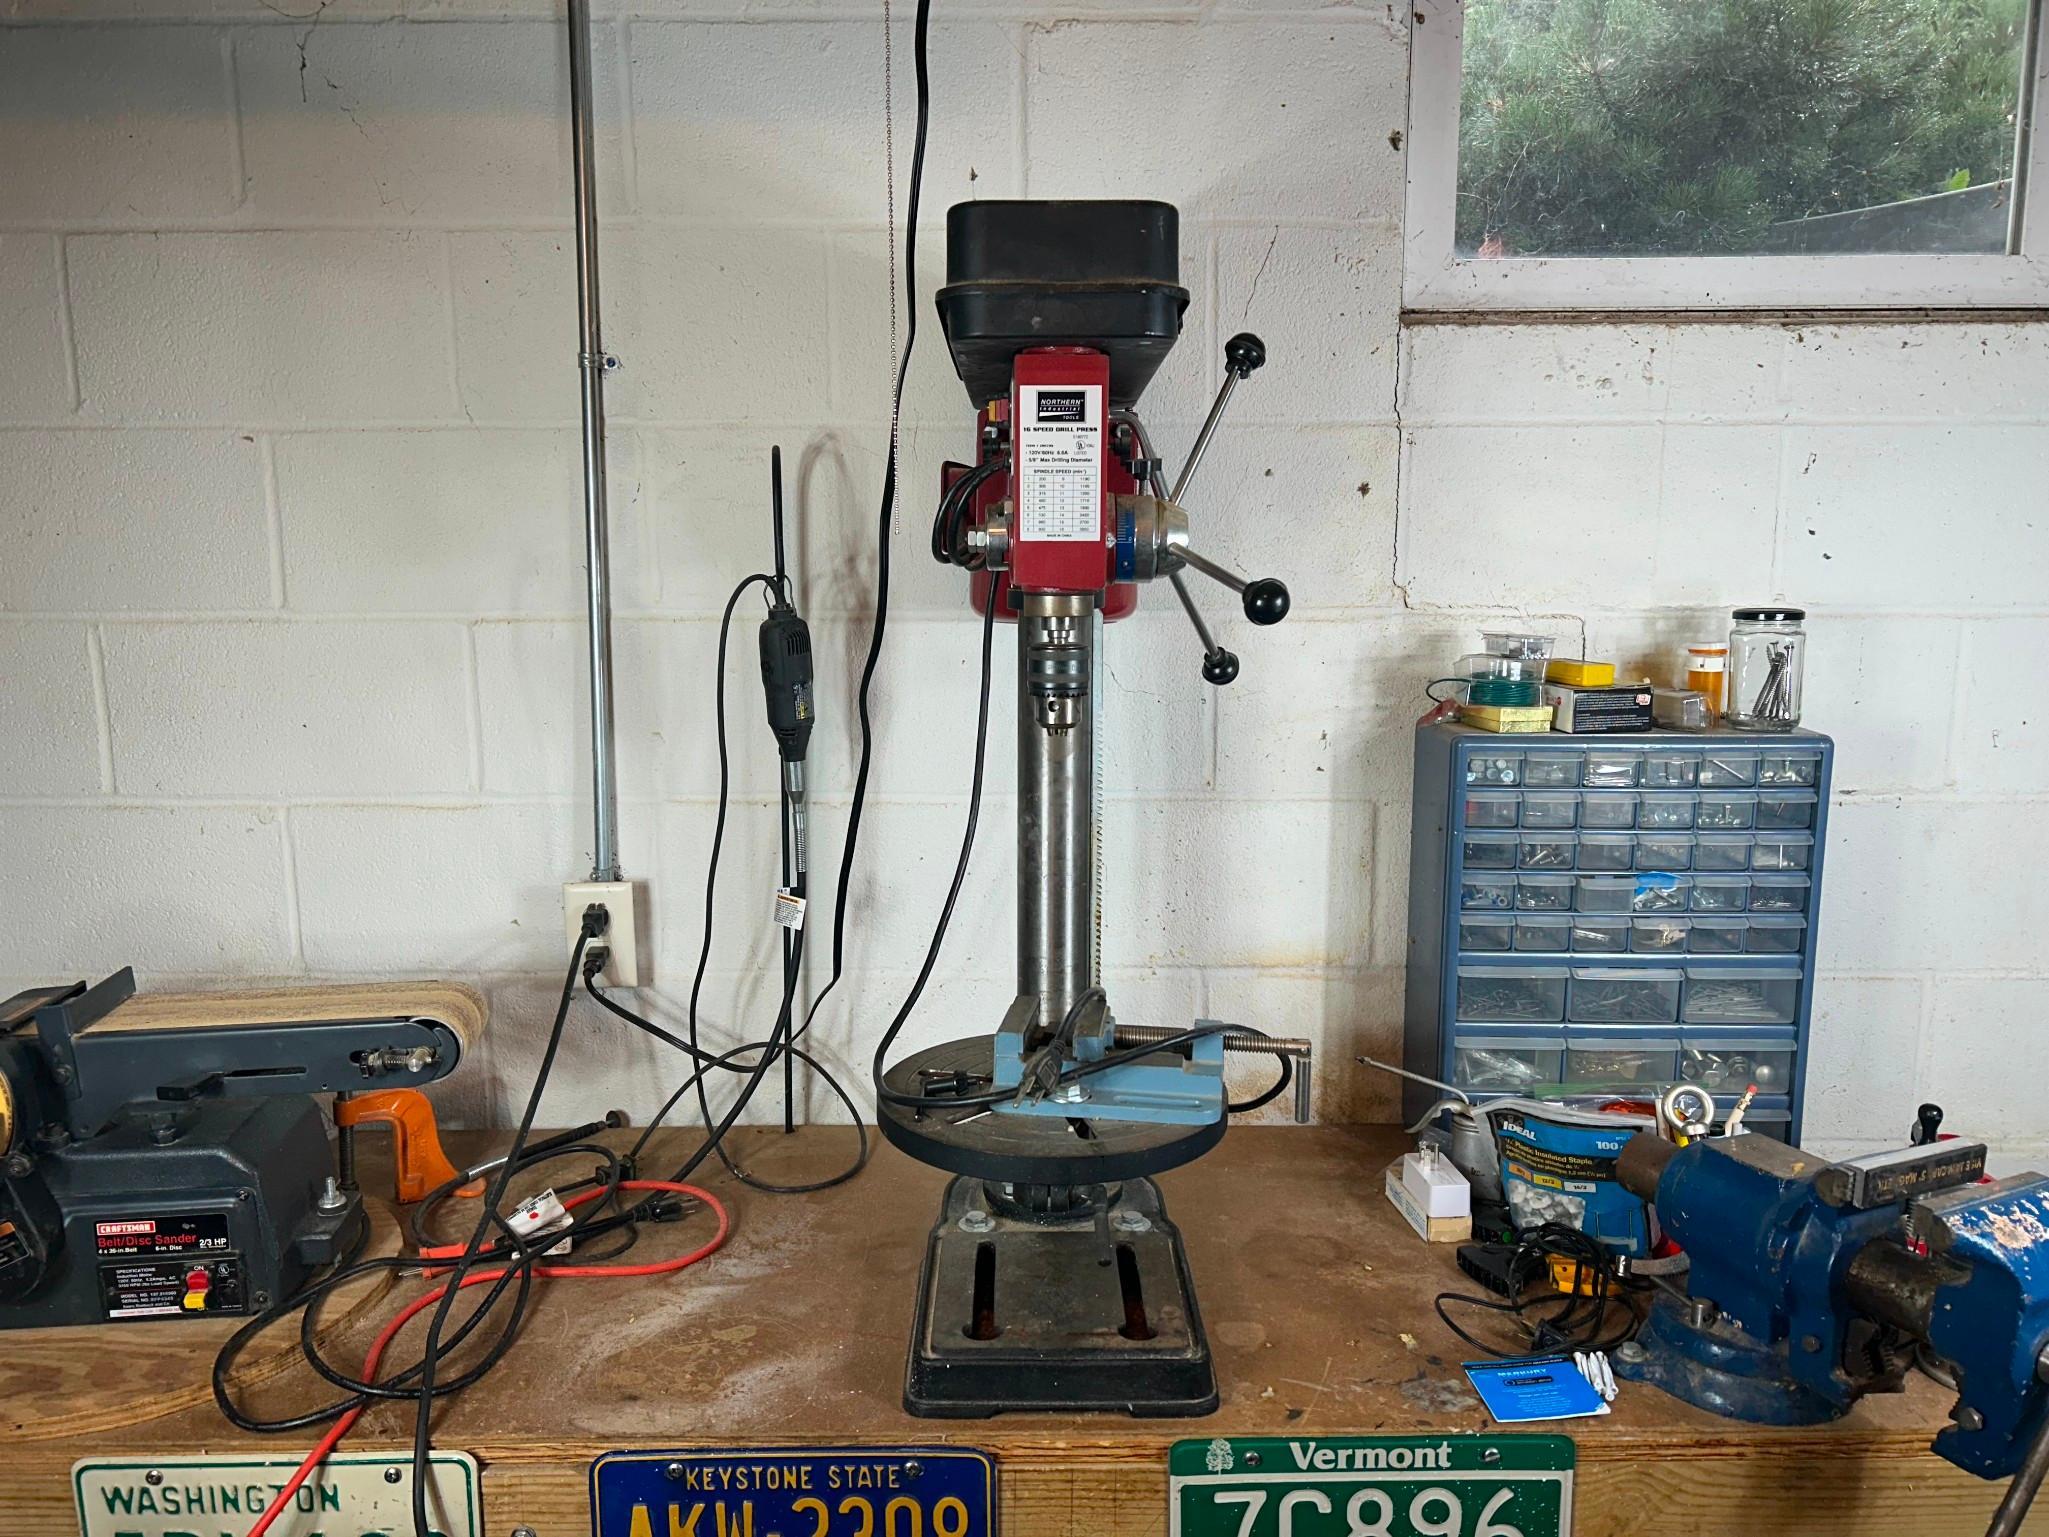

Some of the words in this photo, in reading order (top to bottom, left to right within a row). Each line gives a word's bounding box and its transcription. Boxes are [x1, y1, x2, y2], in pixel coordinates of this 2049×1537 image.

[1502, 1120, 1537, 1141] IDEAL
[1596, 1141, 1619, 1150] 100
[1535, 1147, 1567, 1163] Insulated
[1569, 1156, 1593, 1165] Staple
[100, 1223, 151, 1234] CRAFTSMAN
[98, 1235, 152, 1248] Belt/Disc
[154, 1233, 197, 1245] Sander
[1289, 1441, 1453, 1470] Vermont
[686, 1464, 813, 1491] KEYSTONE
[828, 1464, 901, 1490] STATE
[101, 1484, 340, 1515] WASHINGTON
